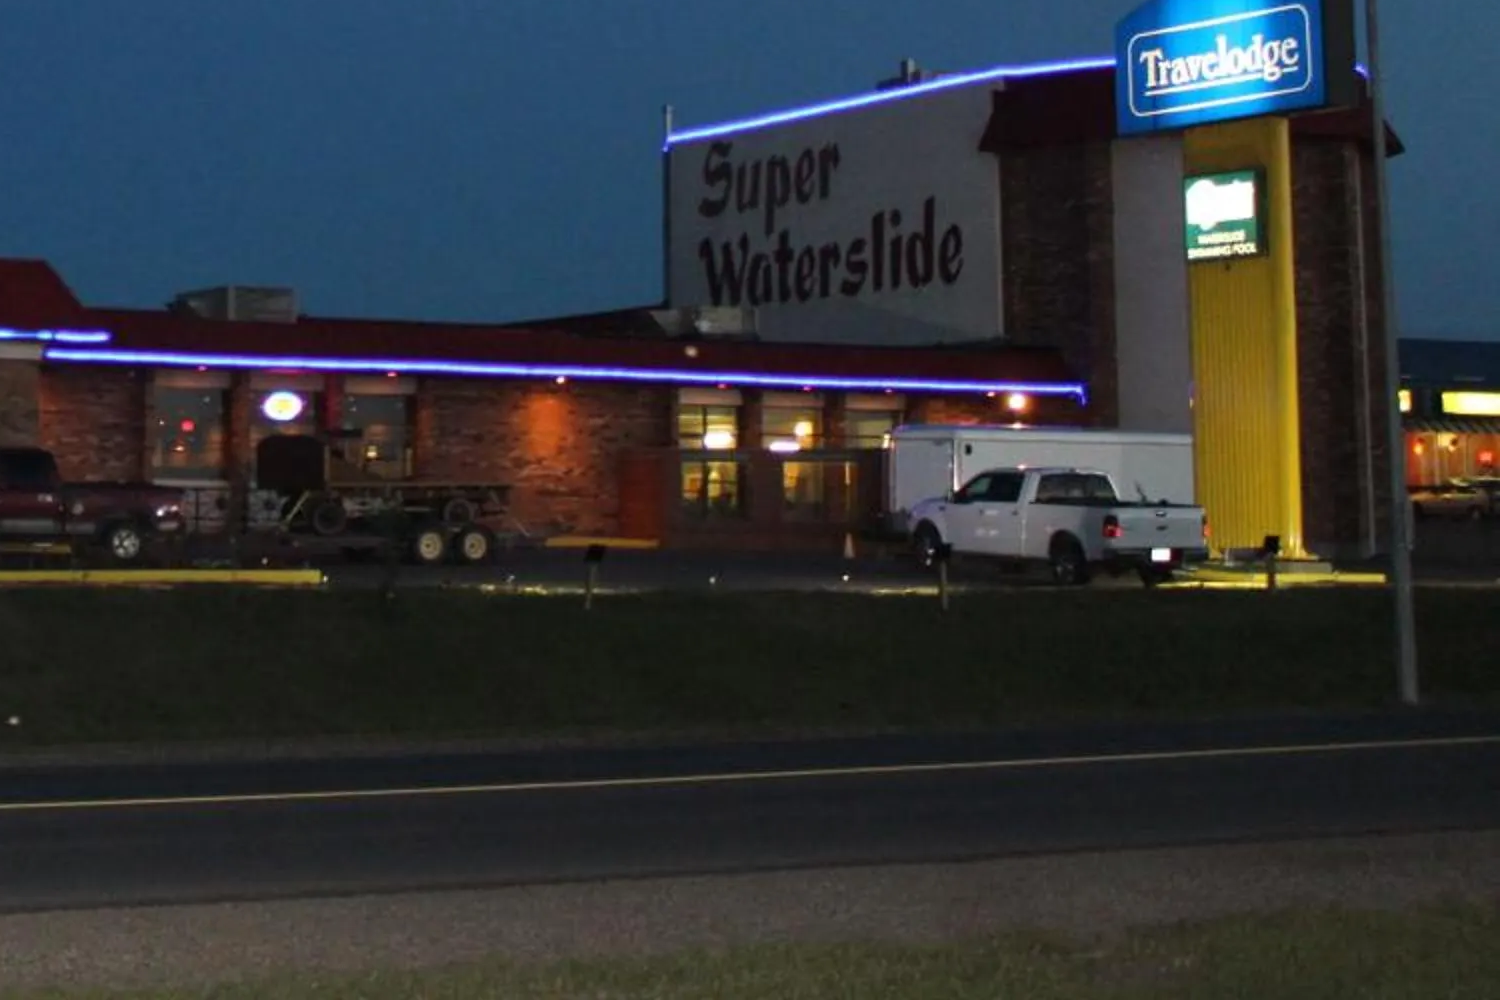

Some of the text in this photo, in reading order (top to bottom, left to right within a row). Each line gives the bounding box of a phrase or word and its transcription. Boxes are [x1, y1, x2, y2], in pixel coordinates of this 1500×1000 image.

[1140, 33, 1299, 90] Travelodge
[699, 141, 840, 236] Super
[699, 196, 964, 307] Waterslide
